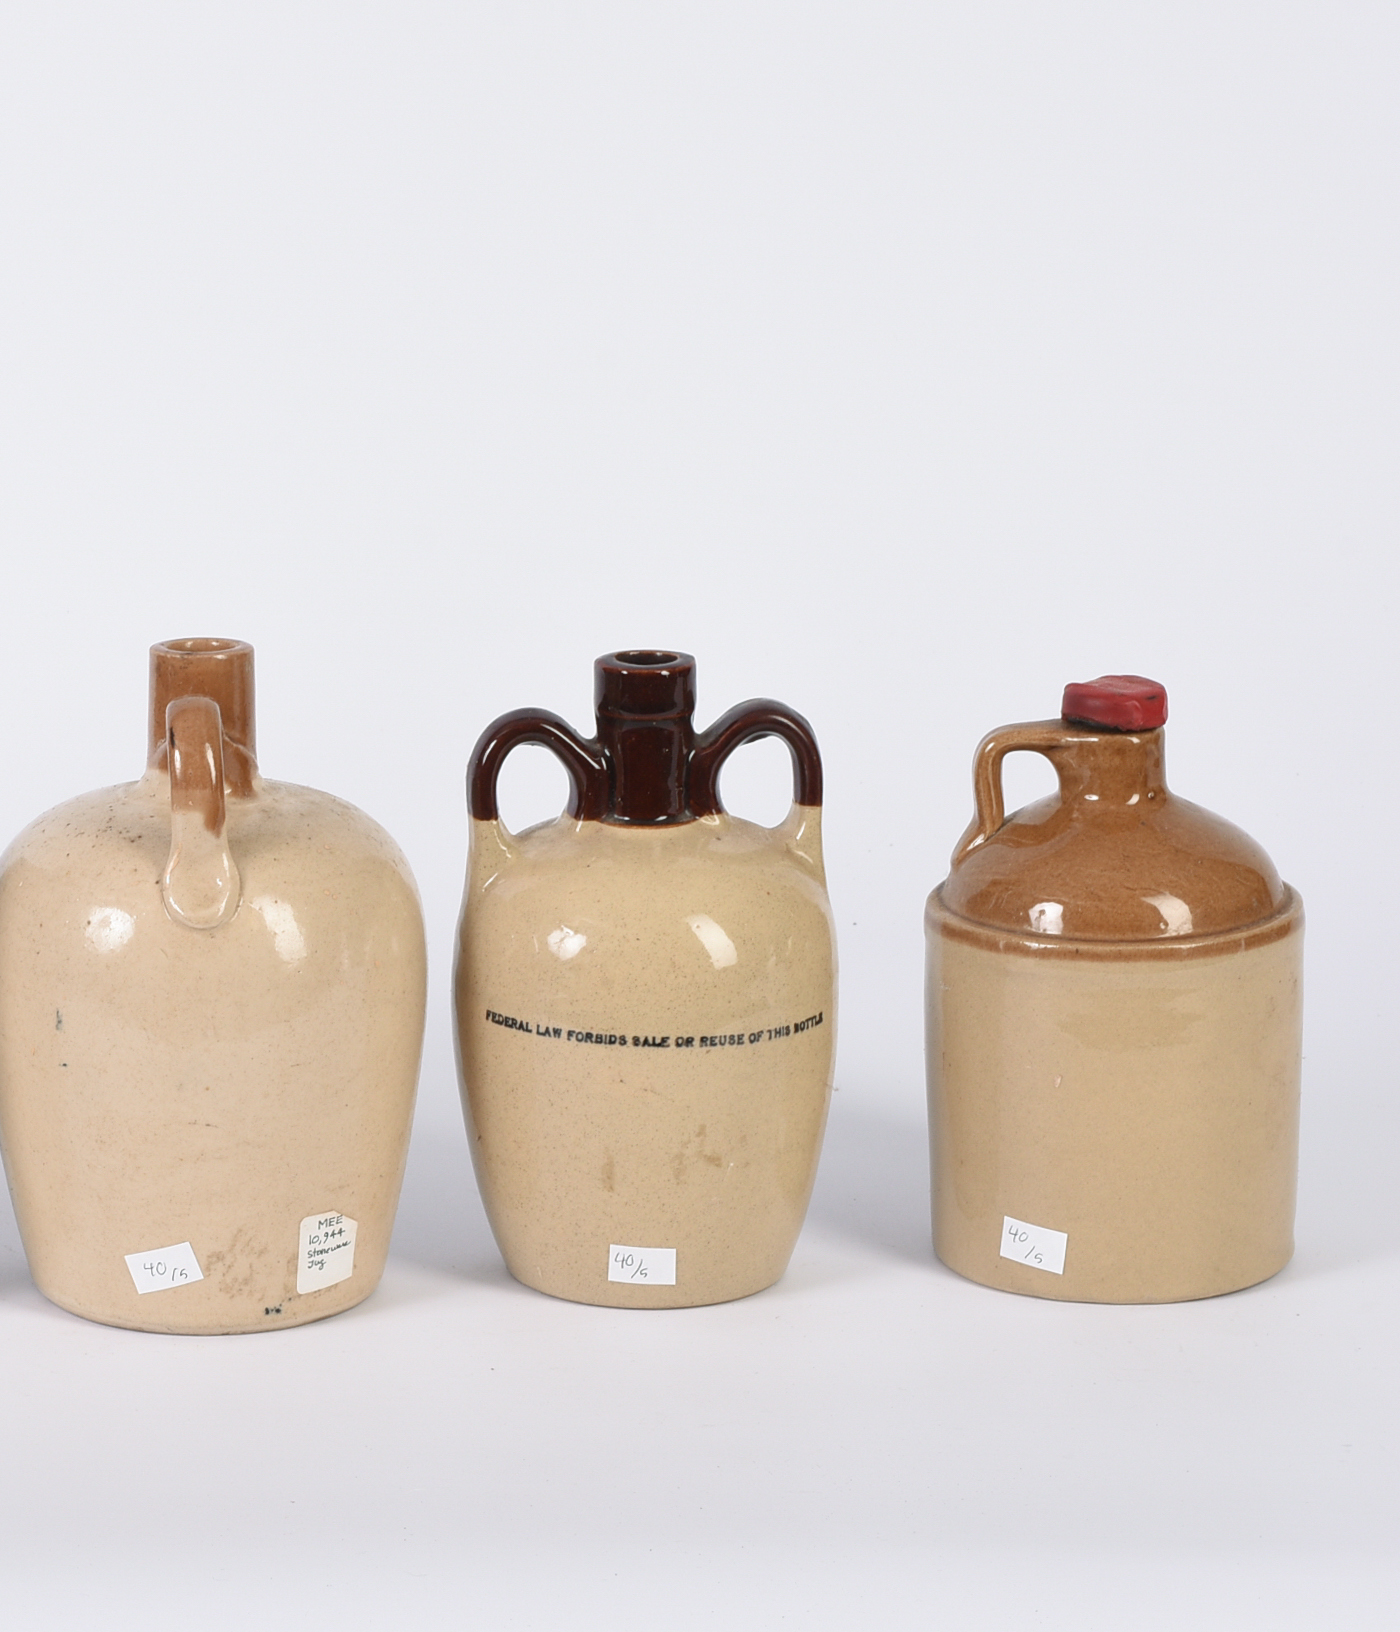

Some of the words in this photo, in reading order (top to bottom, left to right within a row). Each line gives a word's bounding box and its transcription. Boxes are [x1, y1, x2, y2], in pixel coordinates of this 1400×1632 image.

[486, 1009, 532, 1033] FEDERAL
[536, 1024, 562, 1039] LAW
[567, 1030, 627, 1046] FORBIDS
[632, 1035, 670, 1048] SALE
[674, 1036, 695, 1048] OR
[699, 1033, 745, 1048] REUSE
[748, 1030, 764, 1044] OF
[767, 1024, 791, 1041] THIS
[794, 1011, 824, 1034] BOTTLE
[318, 1214, 344, 1230] MEE
[309, 1227, 346, 1246] 10,944
